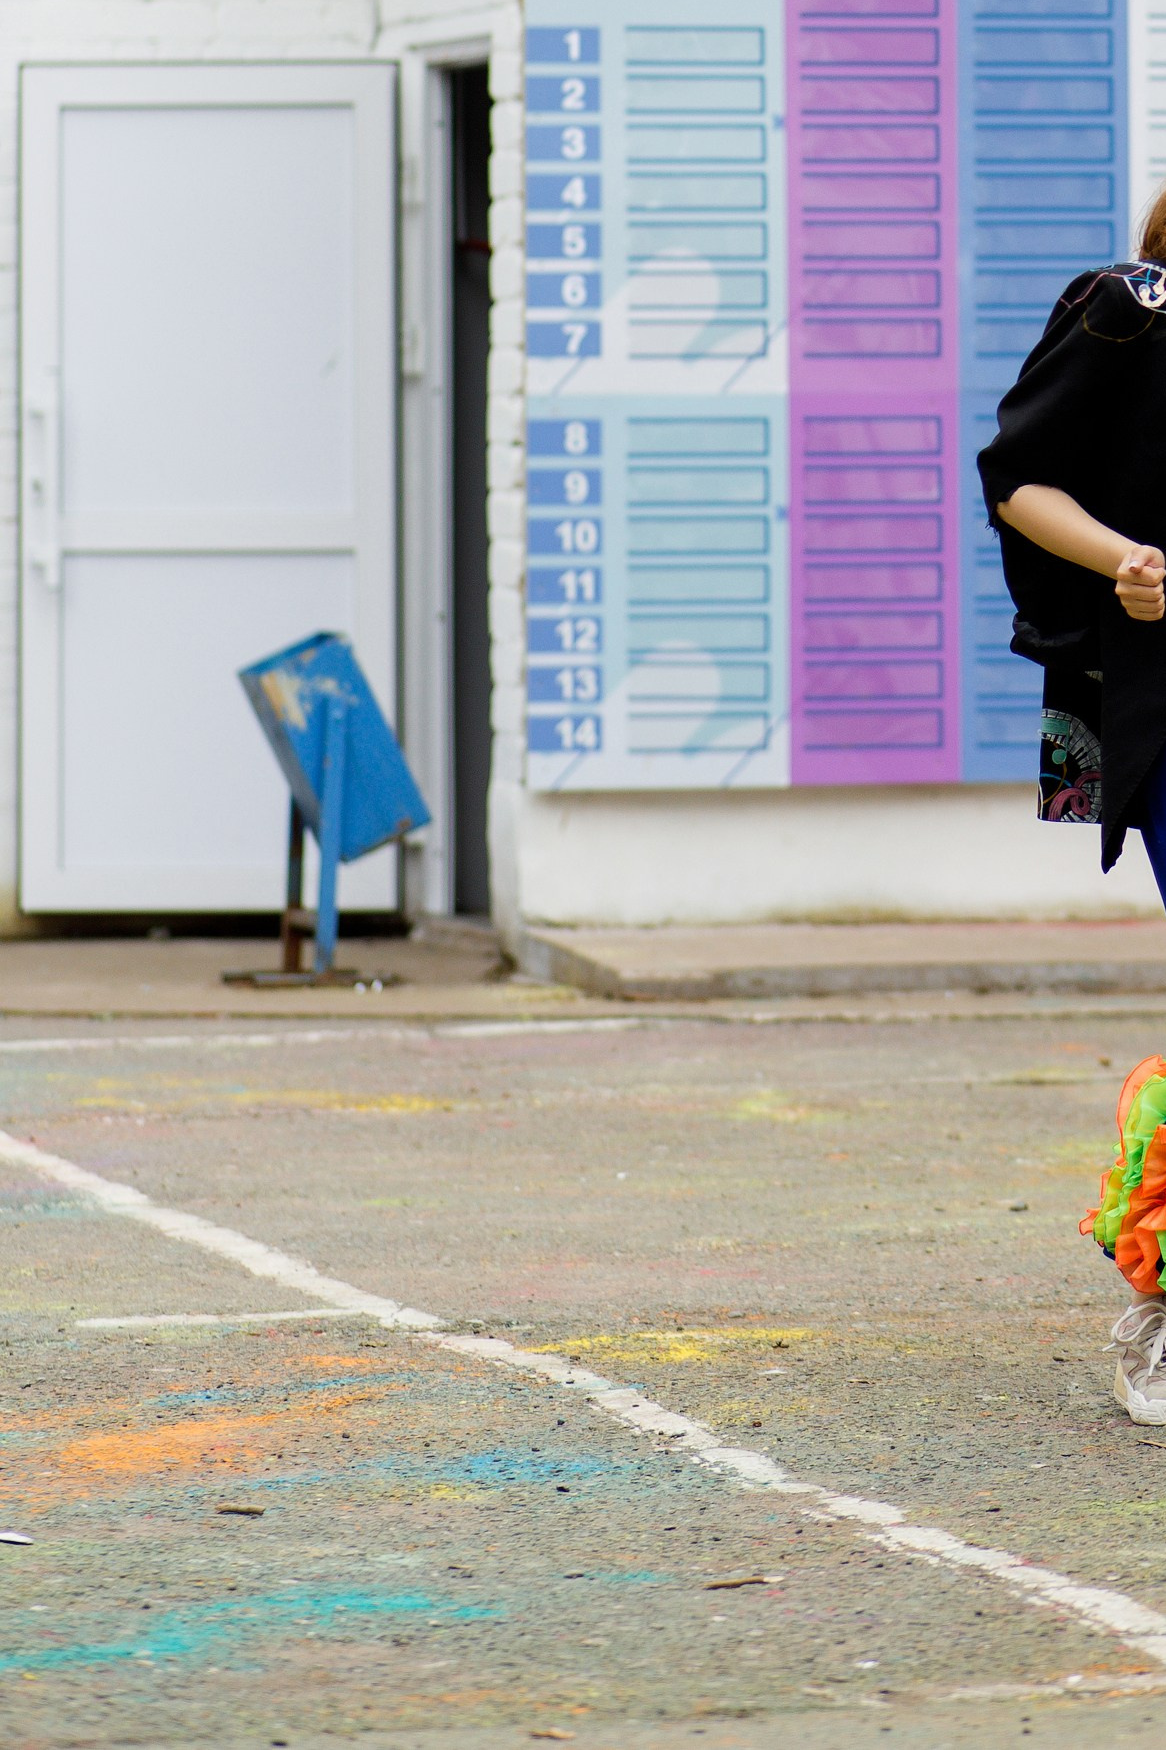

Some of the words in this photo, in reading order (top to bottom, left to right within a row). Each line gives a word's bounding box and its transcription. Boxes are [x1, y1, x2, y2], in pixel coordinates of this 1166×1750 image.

[563, 31, 581, 60] 1
[561, 79, 586, 110] 2
[561, 128, 586, 159] 3
[561, 177, 587, 208] 4
[562, 226, 587, 257] 5
[561, 275, 587, 306] 6
[563, 324, 587, 354] 7
[564, 422, 588, 453] 8
[564, 471, 588, 502] 9
[555, 521, 598, 552] 10
[559, 571, 596, 601] 11
[555, 620, 598, 651] 12
[555, 669, 598, 700] 13
[556, 718, 597, 749] 14
